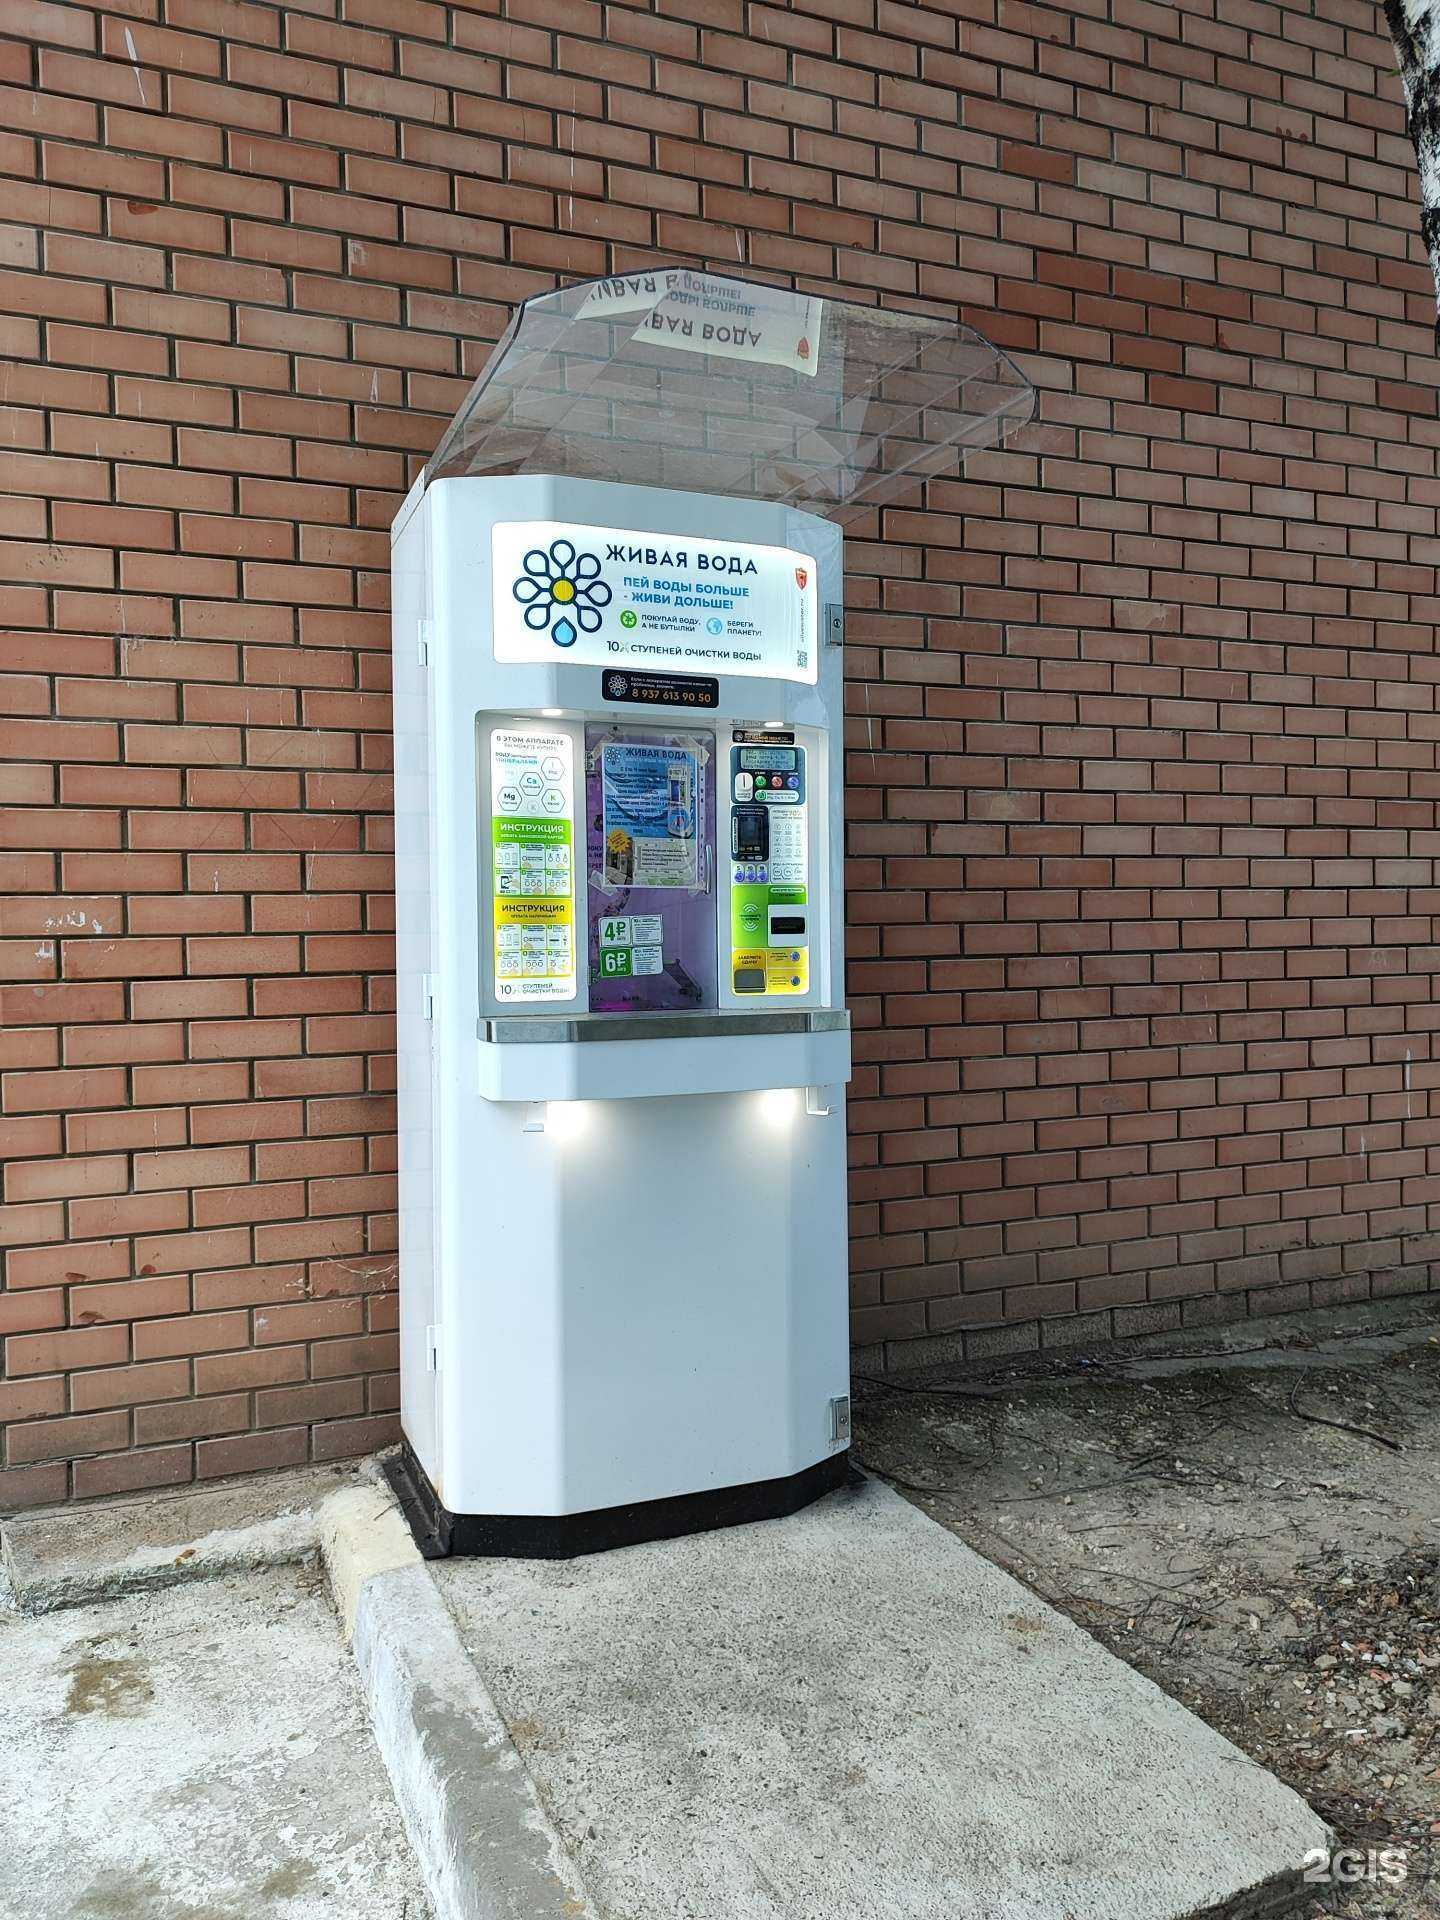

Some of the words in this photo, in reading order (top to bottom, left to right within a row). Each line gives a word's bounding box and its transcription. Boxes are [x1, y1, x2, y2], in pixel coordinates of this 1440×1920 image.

[606, 544, 688, 568] ЖИВАЯ
[697, 553, 758, 575] ВОДА
[624, 576, 650, 589] ПЕЙ
[653, 580, 692, 592] ВОДЫ
[695, 584, 750, 597] БОЛЬШЕ
[632, 592, 671, 605] ЖИВИ
[674, 596, 734, 610] ДОЛЬШЕ!
[641, 614, 678, 624] ПОКУПАЙ
[679, 617, 701, 626] ВОДУ,
[727, 620, 754, 628] БЕРЕГИ
[660, 624, 696, 632] БУТЫЛКИ
[727, 629, 762, 637] ПЛАНЕТУ!
[630, 643, 682, 655] СТУПЕНЕЙ
[684, 648, 730, 659] ОЧИСТКИ
[732, 652, 762, 661] ВОДЫ
[632, 688, 639, 698] 8
[641, 689, 660, 699] 937
[662, 691, 680, 701] 613
[682, 692, 695, 702] 90
[698, 693, 711, 703] 50
[625, 747, 659, 758] ЖИВАЯ
[662, 750, 687, 760] ВОДА
[504, 793, 516, 801] Mg
[500, 823, 564, 833] ИНСТРУКЦИЯ
[502, 904, 565, 913] ИНСТРУКЦИЯ
[500, 984, 512, 995] 10
